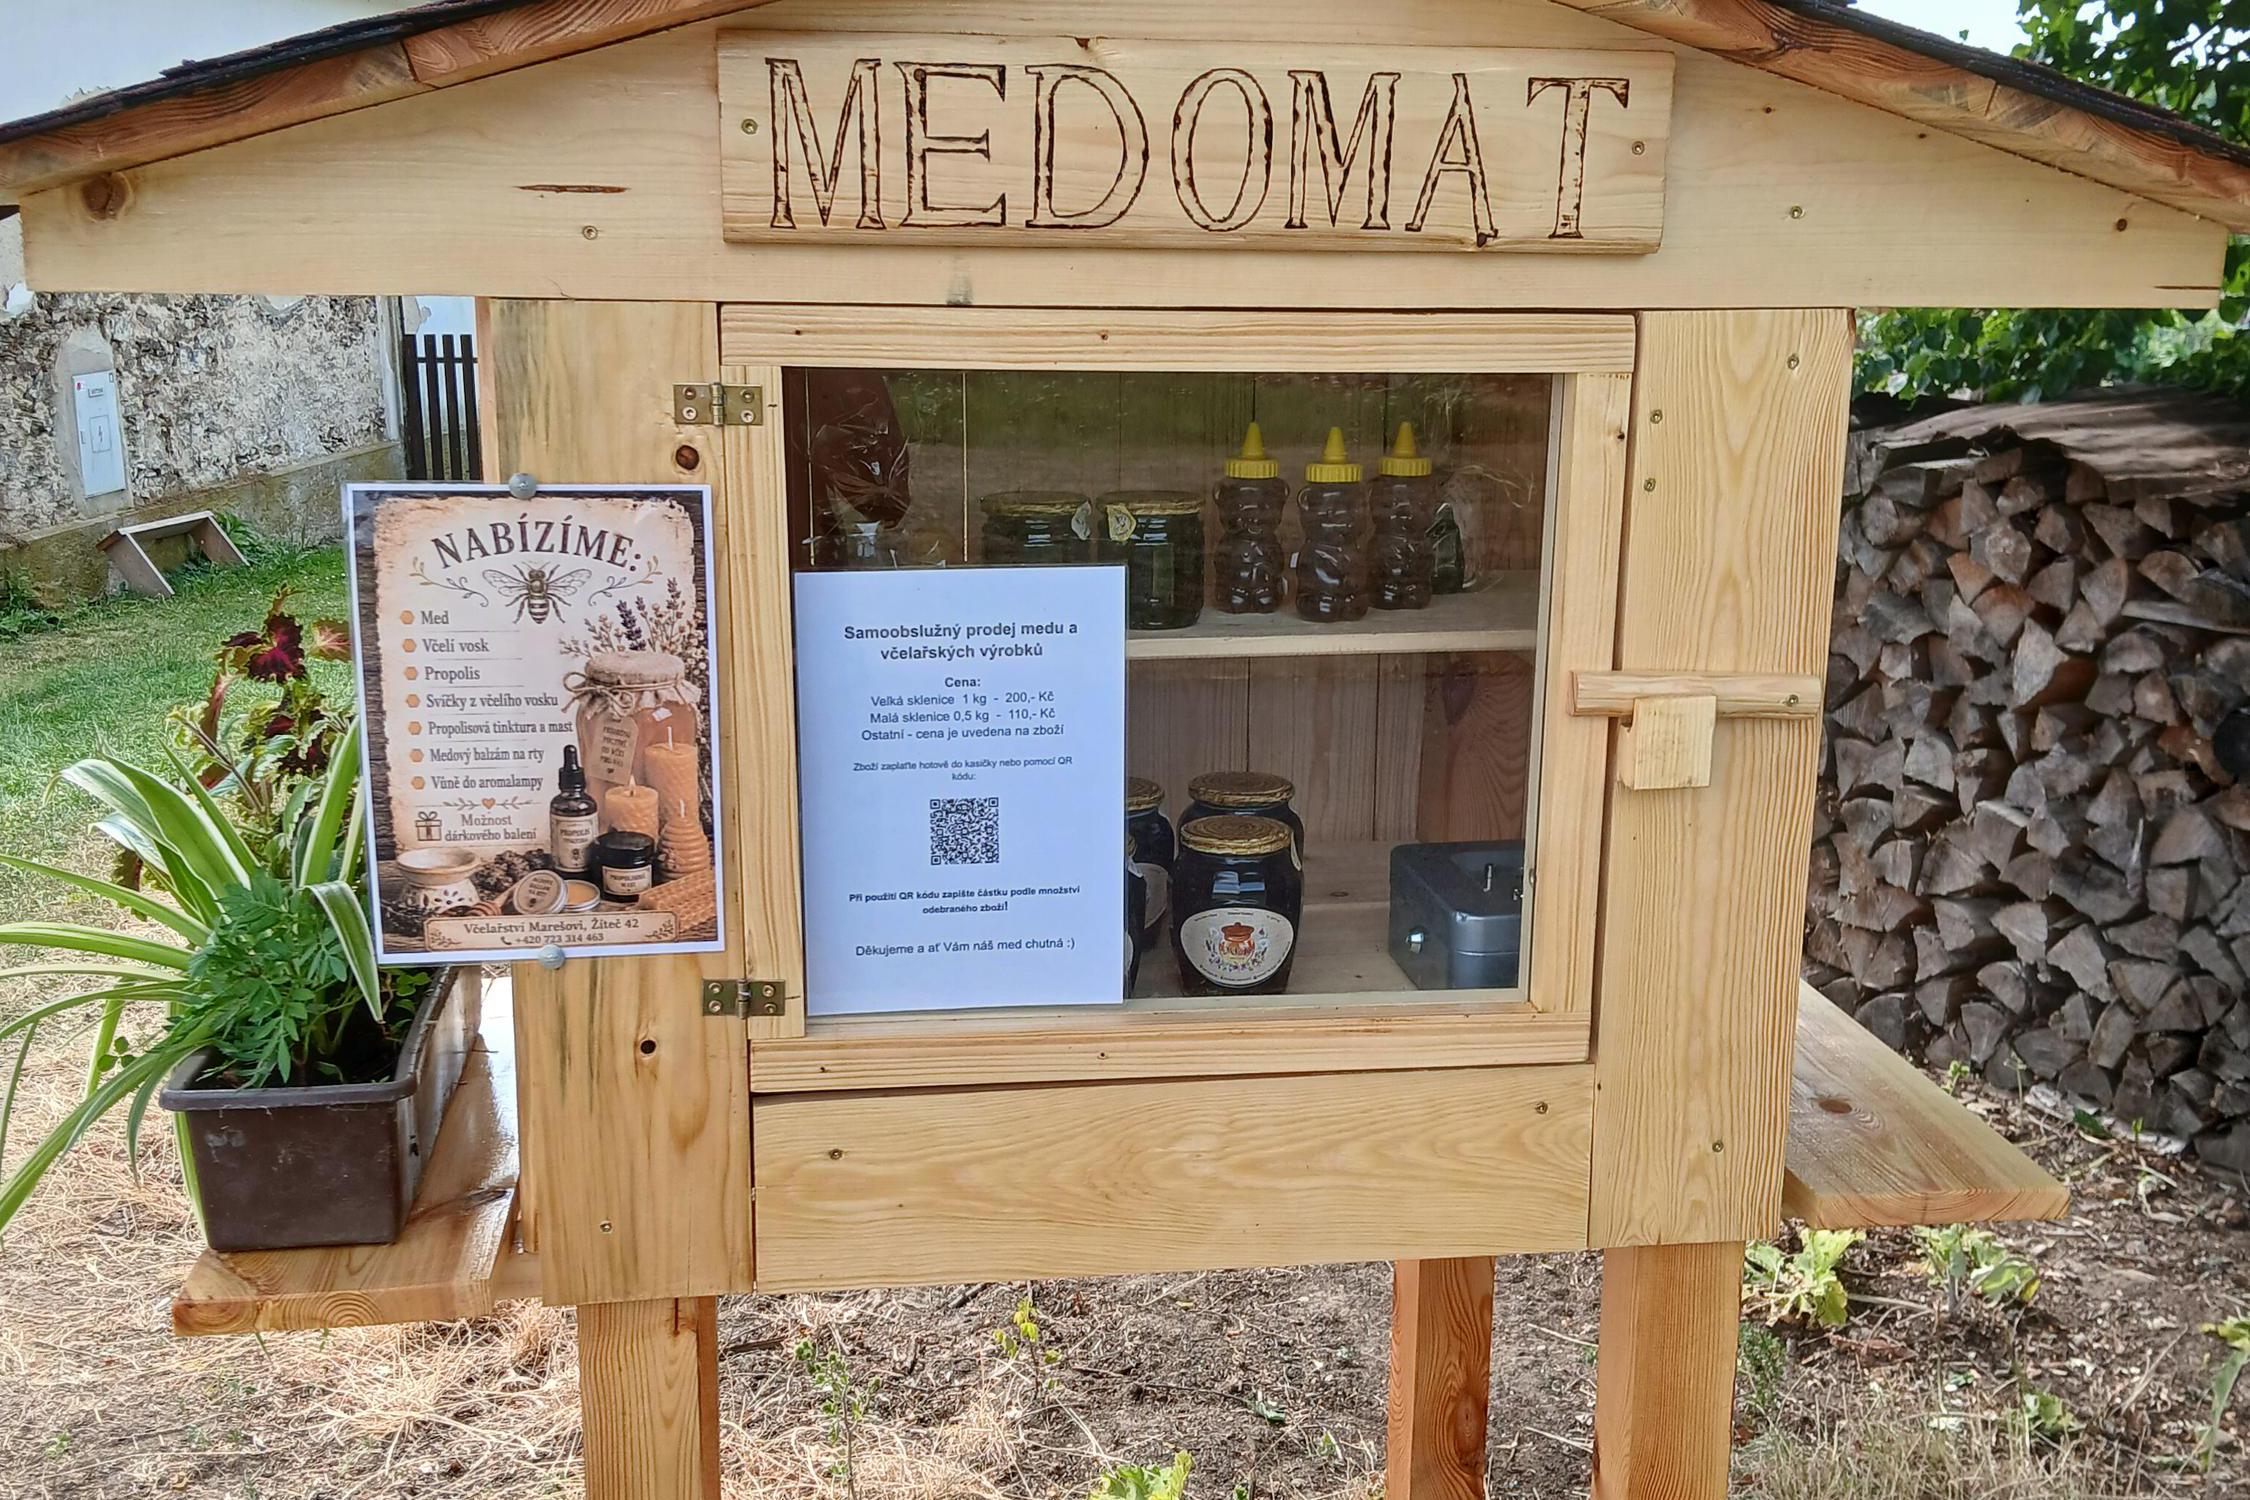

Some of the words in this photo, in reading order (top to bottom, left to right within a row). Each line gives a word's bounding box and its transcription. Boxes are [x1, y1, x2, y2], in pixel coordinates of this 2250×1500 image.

[764, 58, 1630, 247] MEDOMAT
[431, 513, 642, 572] NABÍZÍME:
[421, 611, 449, 625] Med
[844, 624, 961, 640] Samoobslužný
[966, 623, 1016, 639] prodej
[1021, 622, 1064, 635] medu
[1069, 625, 1078, 634] a
[423, 638, 455, 653] Včelí
[459, 639, 489, 652] vosk
[881, 645, 975, 662] včelařských
[980, 643, 1043, 660] výrobků
[424, 666, 480, 682] Propolis
[945, 677, 980, 688] Cena:
[427, 693, 467, 712] Svíčky
[470, 697, 478, 707] z
[480, 693, 522, 707] včelího
[525, 694, 558, 706] vosku
[871, 695, 903, 707] Velká
[907, 695, 955, 705] sklenice
[963, 695, 968, 704] 1
[972, 694, 987, 706] kg
[1005, 692, 1035, 704] 200,-
[1039, 691, 1054, 702] Kč
[870, 713, 899, 723] Malá
[902, 711, 950, 722] sklenice
[954, 711, 972, 723] 0,5
[975, 711, 989, 723] kg
[1009, 709, 1037, 721] 110,-
[1040, 708, 1056, 719] Kč
[428, 720, 491, 737] Propolisová
[493, 721, 537, 734] tinktura
[539, 724, 546, 733] a
[549, 721, 573, 732] mast
[862, 729, 904, 740] Ostatní
[916, 729, 944, 739] cena
[948, 728, 958, 740] je
[961, 727, 1011, 737] uvedena
[1015, 727, 1030, 736] na
[1033, 724, 1064, 736] zboží
[430, 748, 471, 765] Medový
[474, 748, 510, 762] balzám
[512, 752, 525, 761] na
[528, 750, 544, 764] rty
[853, 761, 879, 771] Zboží
[919, 760, 949, 770] hotově
[951, 760, 962, 769] do
[964, 759, 997, 770] kasičky
[999, 758, 1022, 767] nebo
[1024, 757, 1056, 768] pomocí
[1058, 757, 1072, 766] QR
[431, 775, 461, 790] Vůně
[463, 776, 476, 789] do
[478, 776, 543, 793] aromalampy
[952, 772, 976, 781] kódu:
[461, 812, 513, 827] Možnost
[445, 828, 500, 842] dárkového
[503, 827, 536, 840] balení
[849, 893, 863, 902] Při
[865, 892, 896, 903] použití
[899, 891, 914, 900] QR
[916, 890, 940, 899] kódu
[942, 889, 975, 900] zapište
[977, 888, 1008, 898] částku
[1010, 887, 1036, 897] podle
[1038, 886, 1080, 895] množství
[922, 904, 978, 914] odebraného
[980, 902, 1008, 912] zboží!
[464, 921, 526, 934] Včelařství
[529, 919, 586, 934] Marešovi,
[590, 917, 621, 931] Žíteč
[624, 919, 639, 930] 42
[516, 935, 541, 945] +420
[544, 934, 561, 944] 723
[564, 934, 583, 943] 314
[586, 933, 604, 942] 463
[856, 945, 914, 957] Děkujeme
[928, 942, 940, 953] ať
[943, 941, 970, 952] Vám
[973, 940, 993, 951] náš
[997, 940, 1022, 950] med
[1025, 938, 1064, 949] chutná
